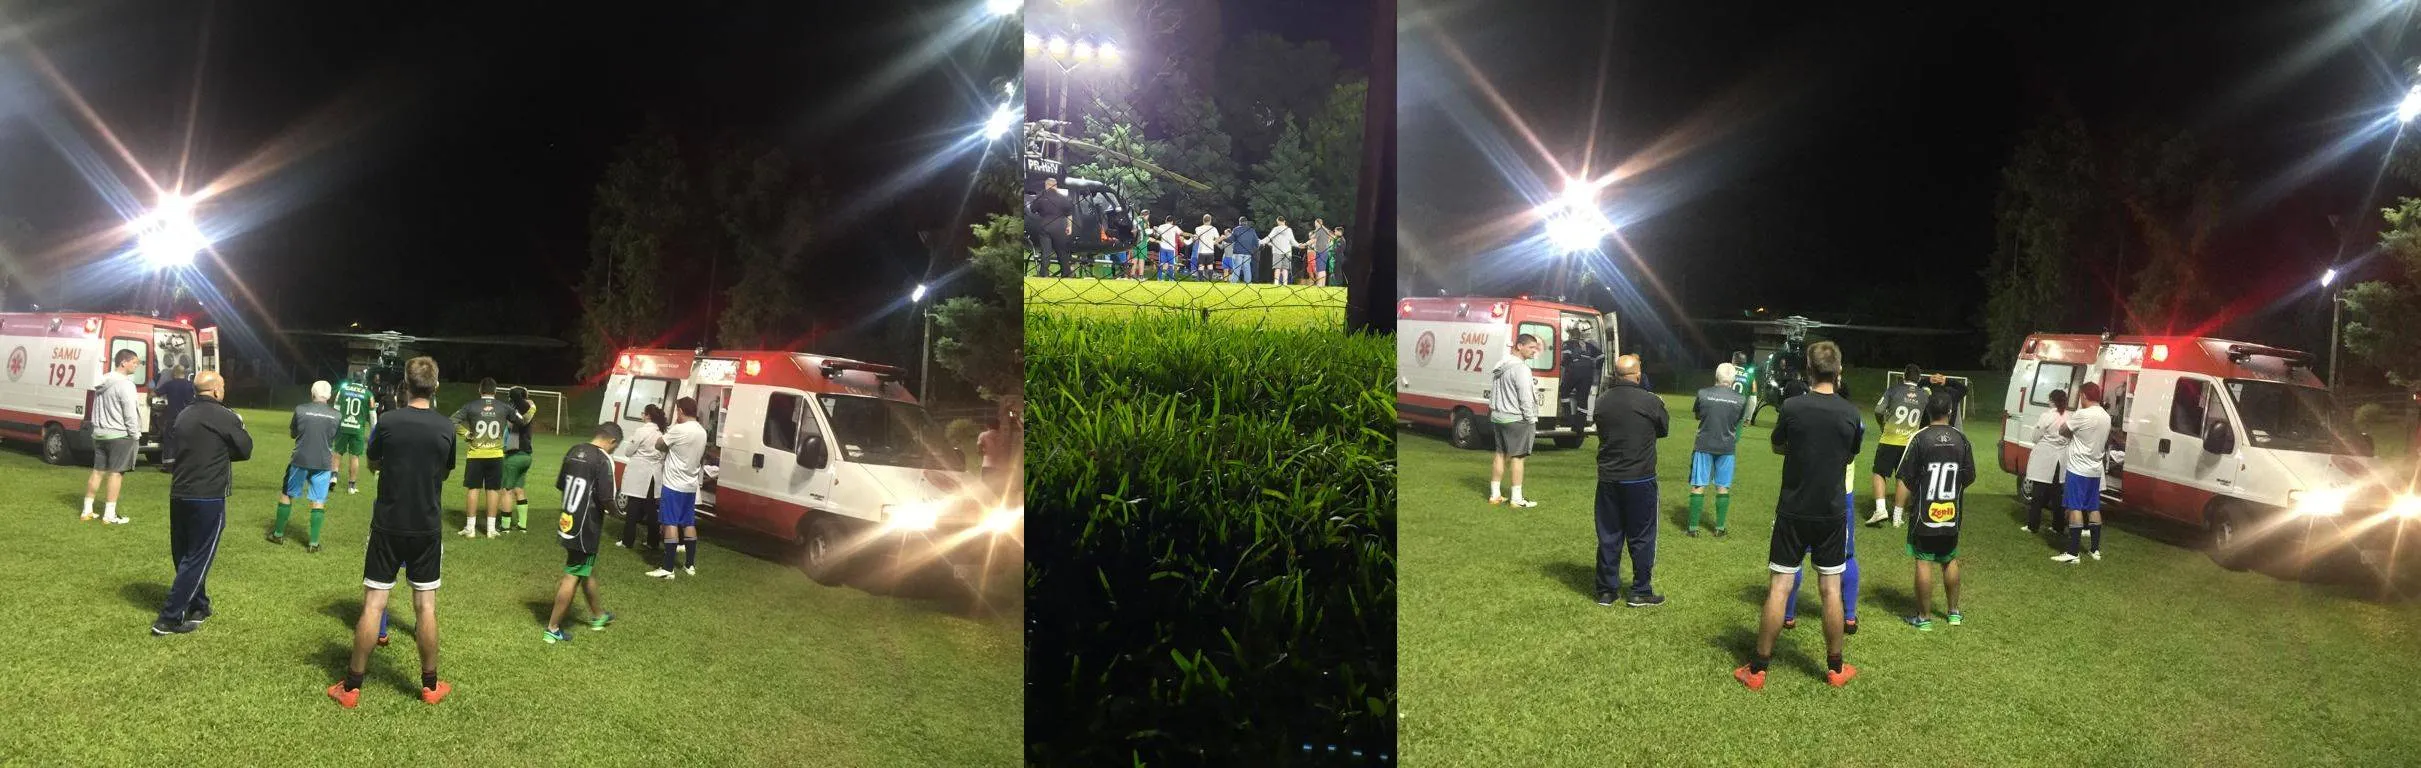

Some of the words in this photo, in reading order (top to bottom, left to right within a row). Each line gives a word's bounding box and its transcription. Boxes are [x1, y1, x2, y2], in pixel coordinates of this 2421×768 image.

[1460, 332, 1489, 345] SAMU
[52, 347, 81, 360] SAMU
[1457, 348, 1484, 372] 192
[48, 363, 76, 388] 192
[345, 396, 361, 416] 10
[1895, 405, 1921, 428] 90
[475, 420, 500, 440] 90
[1926, 462, 1959, 500] 10
[562, 475, 587, 513] 10
